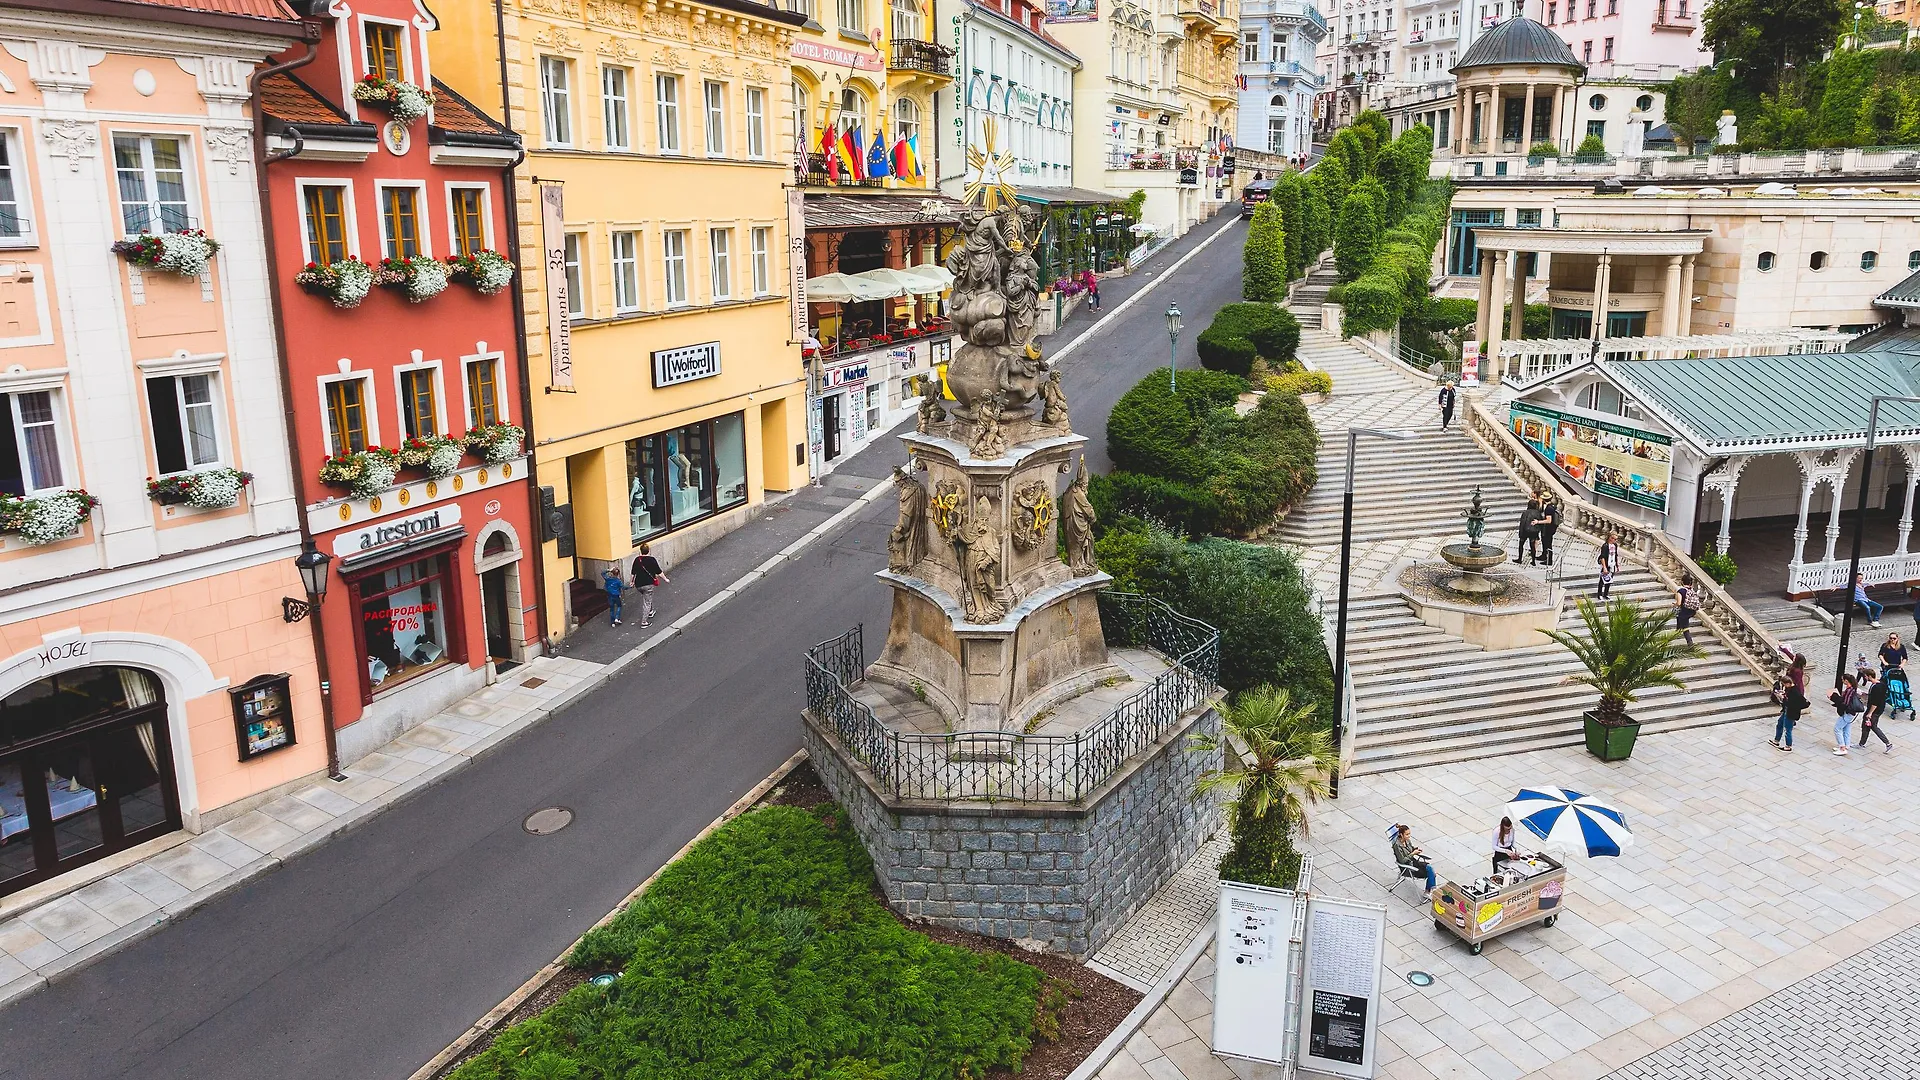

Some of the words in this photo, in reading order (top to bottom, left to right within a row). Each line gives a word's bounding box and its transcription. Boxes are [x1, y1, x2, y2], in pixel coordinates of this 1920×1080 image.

[823, 48, 865, 67] ROMANCE
[791, 237, 804, 255] 35
[549, 248, 564, 271] 35
[797, 265, 808, 334] Apartments
[558, 287, 572, 377] Apartments
[670, 354, 707, 374] Wolford
[843, 364, 868, 382] Market
[360, 511, 441, 549] a.testoni
[364, 602, 438, 621] РАСПРОДАЖА
[383, 617, 419, 634] -70%
[37, 641, 89, 669] HOTEL
[1507, 888, 1533, 906] FRESH
